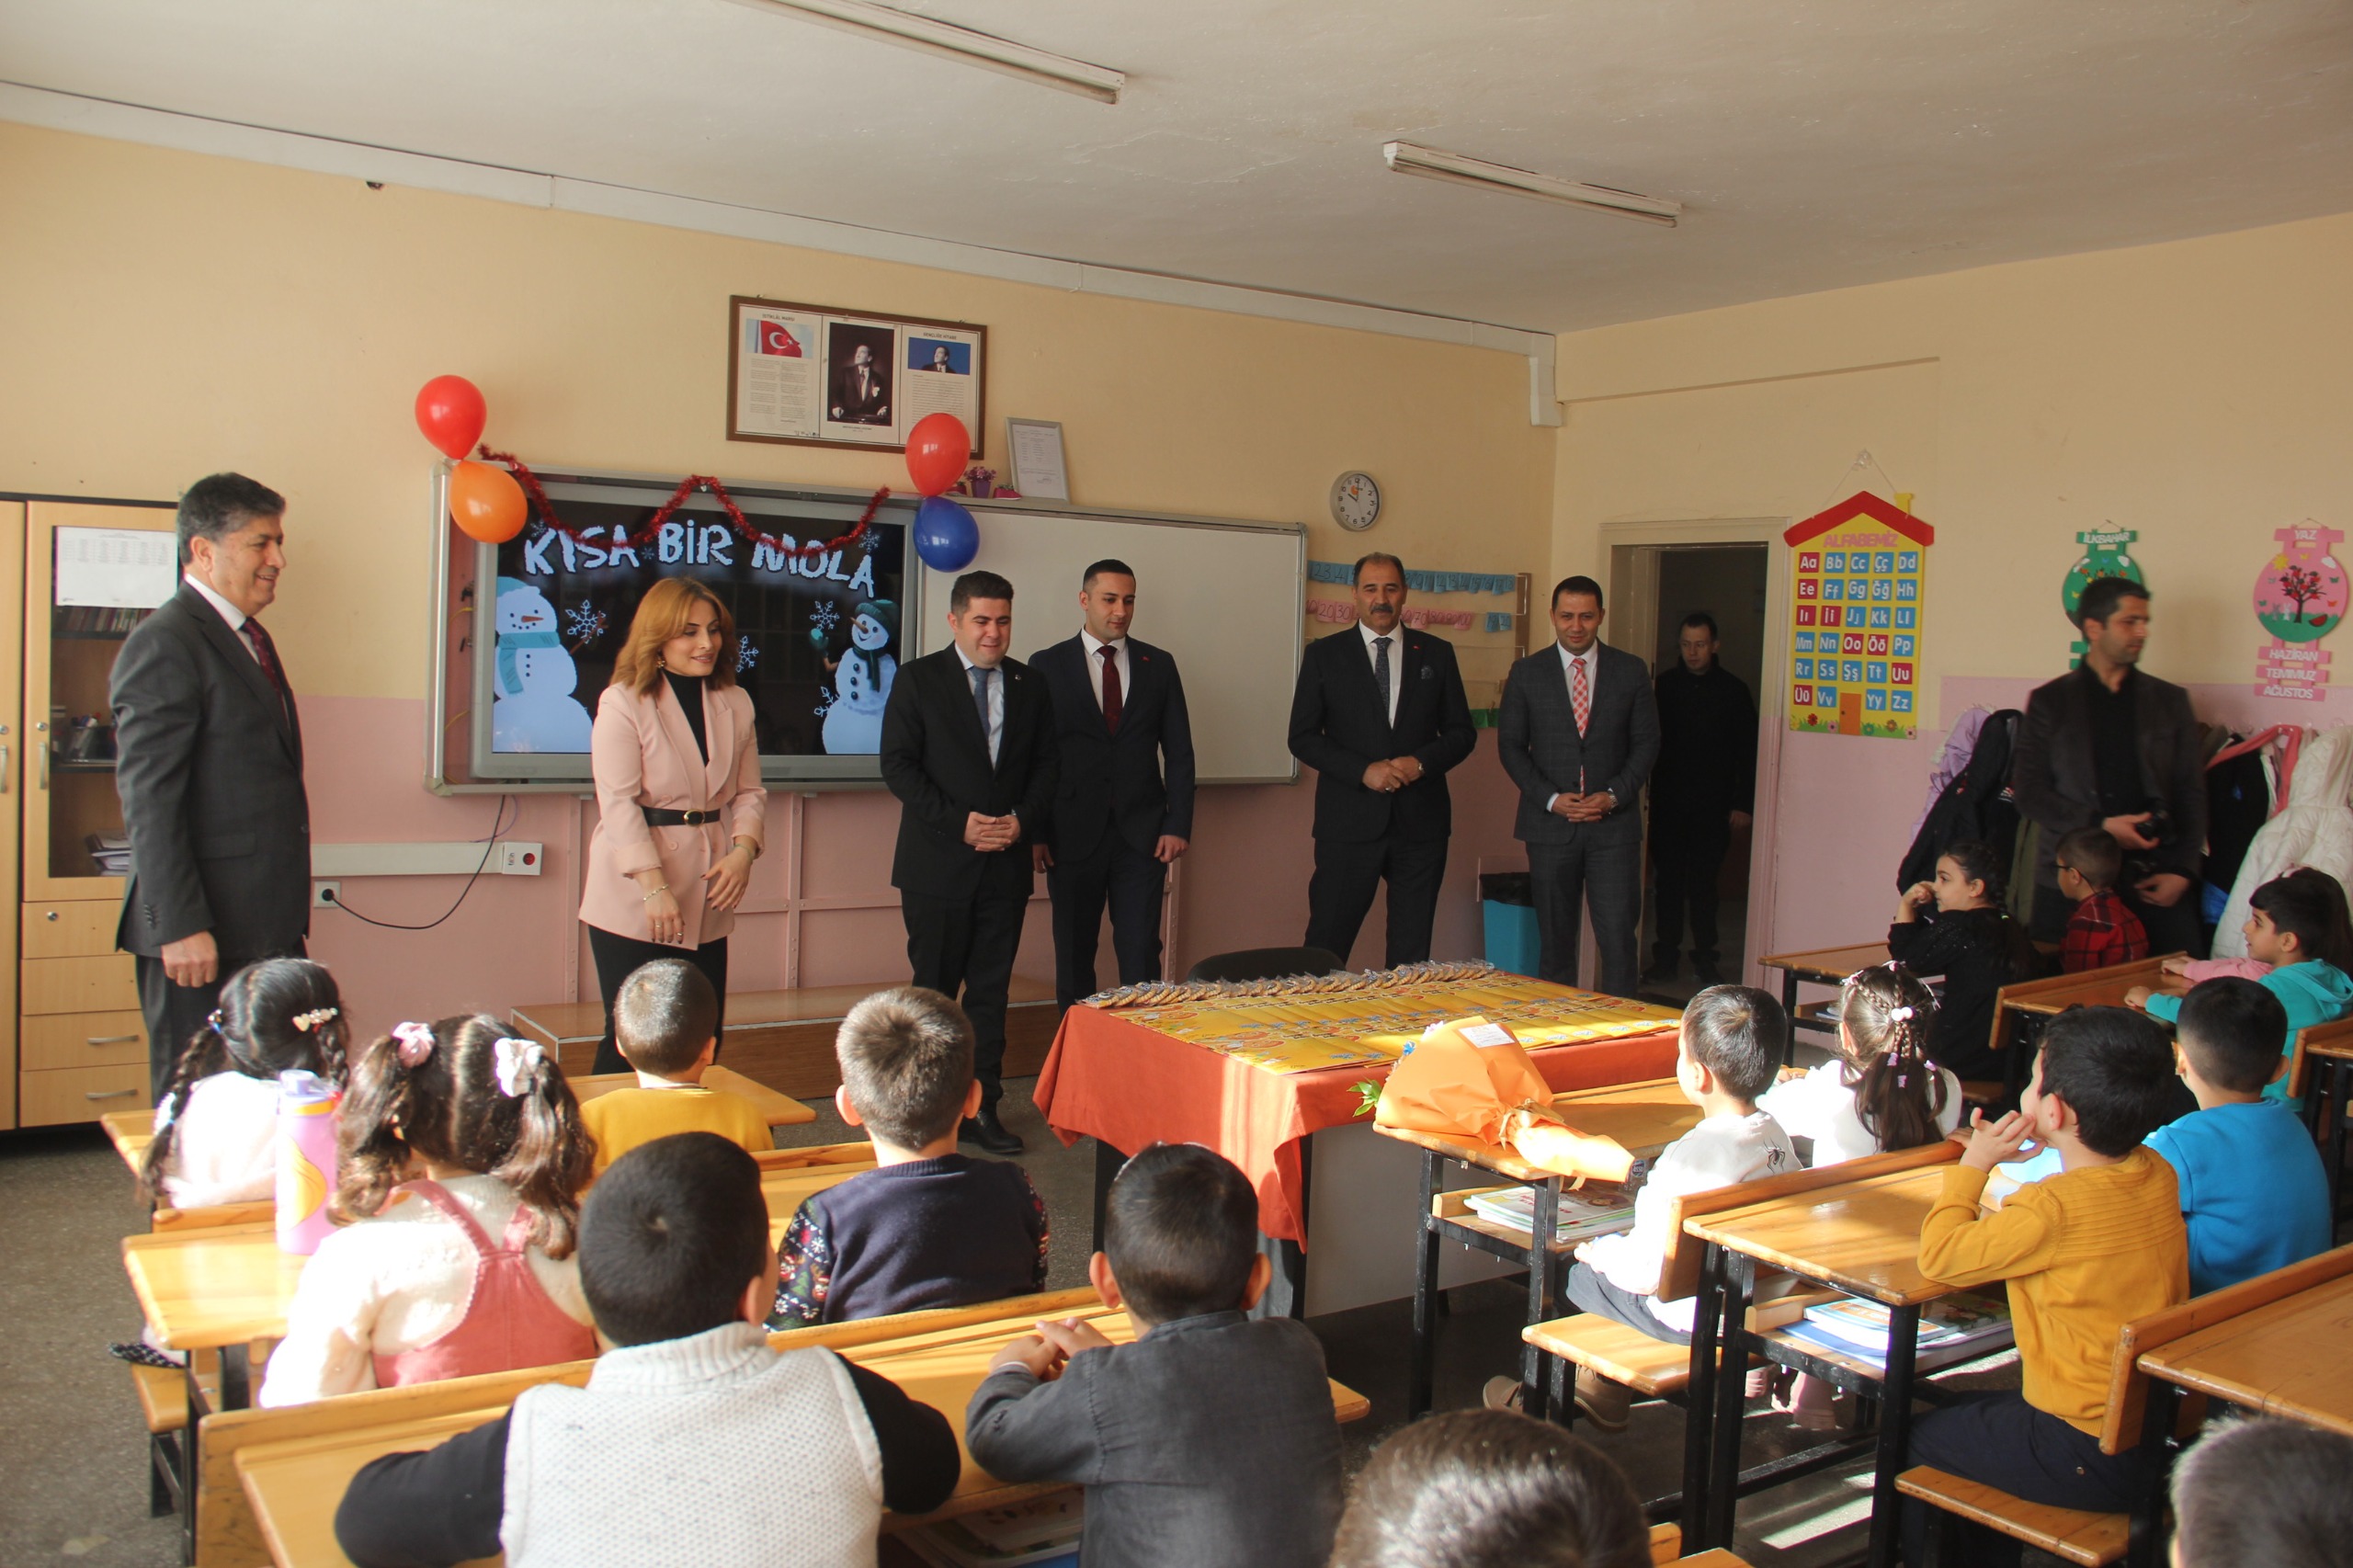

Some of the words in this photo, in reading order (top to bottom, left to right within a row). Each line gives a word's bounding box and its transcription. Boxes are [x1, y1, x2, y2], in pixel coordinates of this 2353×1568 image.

[1824, 529, 1898, 548] ALFABEMİZ
[2083, 532, 2130, 543] İLKBAHAR
[2294, 529, 2317, 540] YAZ
[751, 533, 874, 598] MOLA
[1801, 556, 1816, 568] Aa
[1825, 556, 1843, 569] Bb
[1851, 556, 1866, 569] Cc
[1874, 555, 1889, 573] Çç
[1899, 555, 1916, 569] Dd
[1801, 583, 1814, 595] Ee
[1824, 585, 1838, 598] Ff
[1849, 581, 1866, 598] Gg
[1873, 580, 1890, 599] Ğğ
[1897, 583, 1915, 597] Hh
[1319, 603, 1334, 618] 20
[1336, 604, 1351, 619] 30
[1415, 612, 1427, 625] 70
[1871, 610, 1887, 623] Kk
[1898, 610, 1911, 625] Ll
[1796, 637, 1813, 650] Mm
[1820, 637, 1836, 649] Nn
[1844, 637, 1861, 650] Oo
[1869, 636, 1885, 652] Öö
[1894, 637, 1911, 653] Pp
[2268, 649, 2318, 661] HAZİRAN
[1796, 663, 1809, 675] Rr
[1820, 664, 1836, 676] Ss
[1844, 665, 1859, 682] Şş
[1868, 665, 1882, 679] Tt
[1893, 668, 1909, 681] Uu
[2266, 668, 2316, 680] TEMMUZ
[1818, 691, 1833, 706] Vv
[1867, 694, 1882, 710] Yy
[1893, 696, 1908, 709] Zz
[2263, 685, 2313, 699] AĞUSTOS
